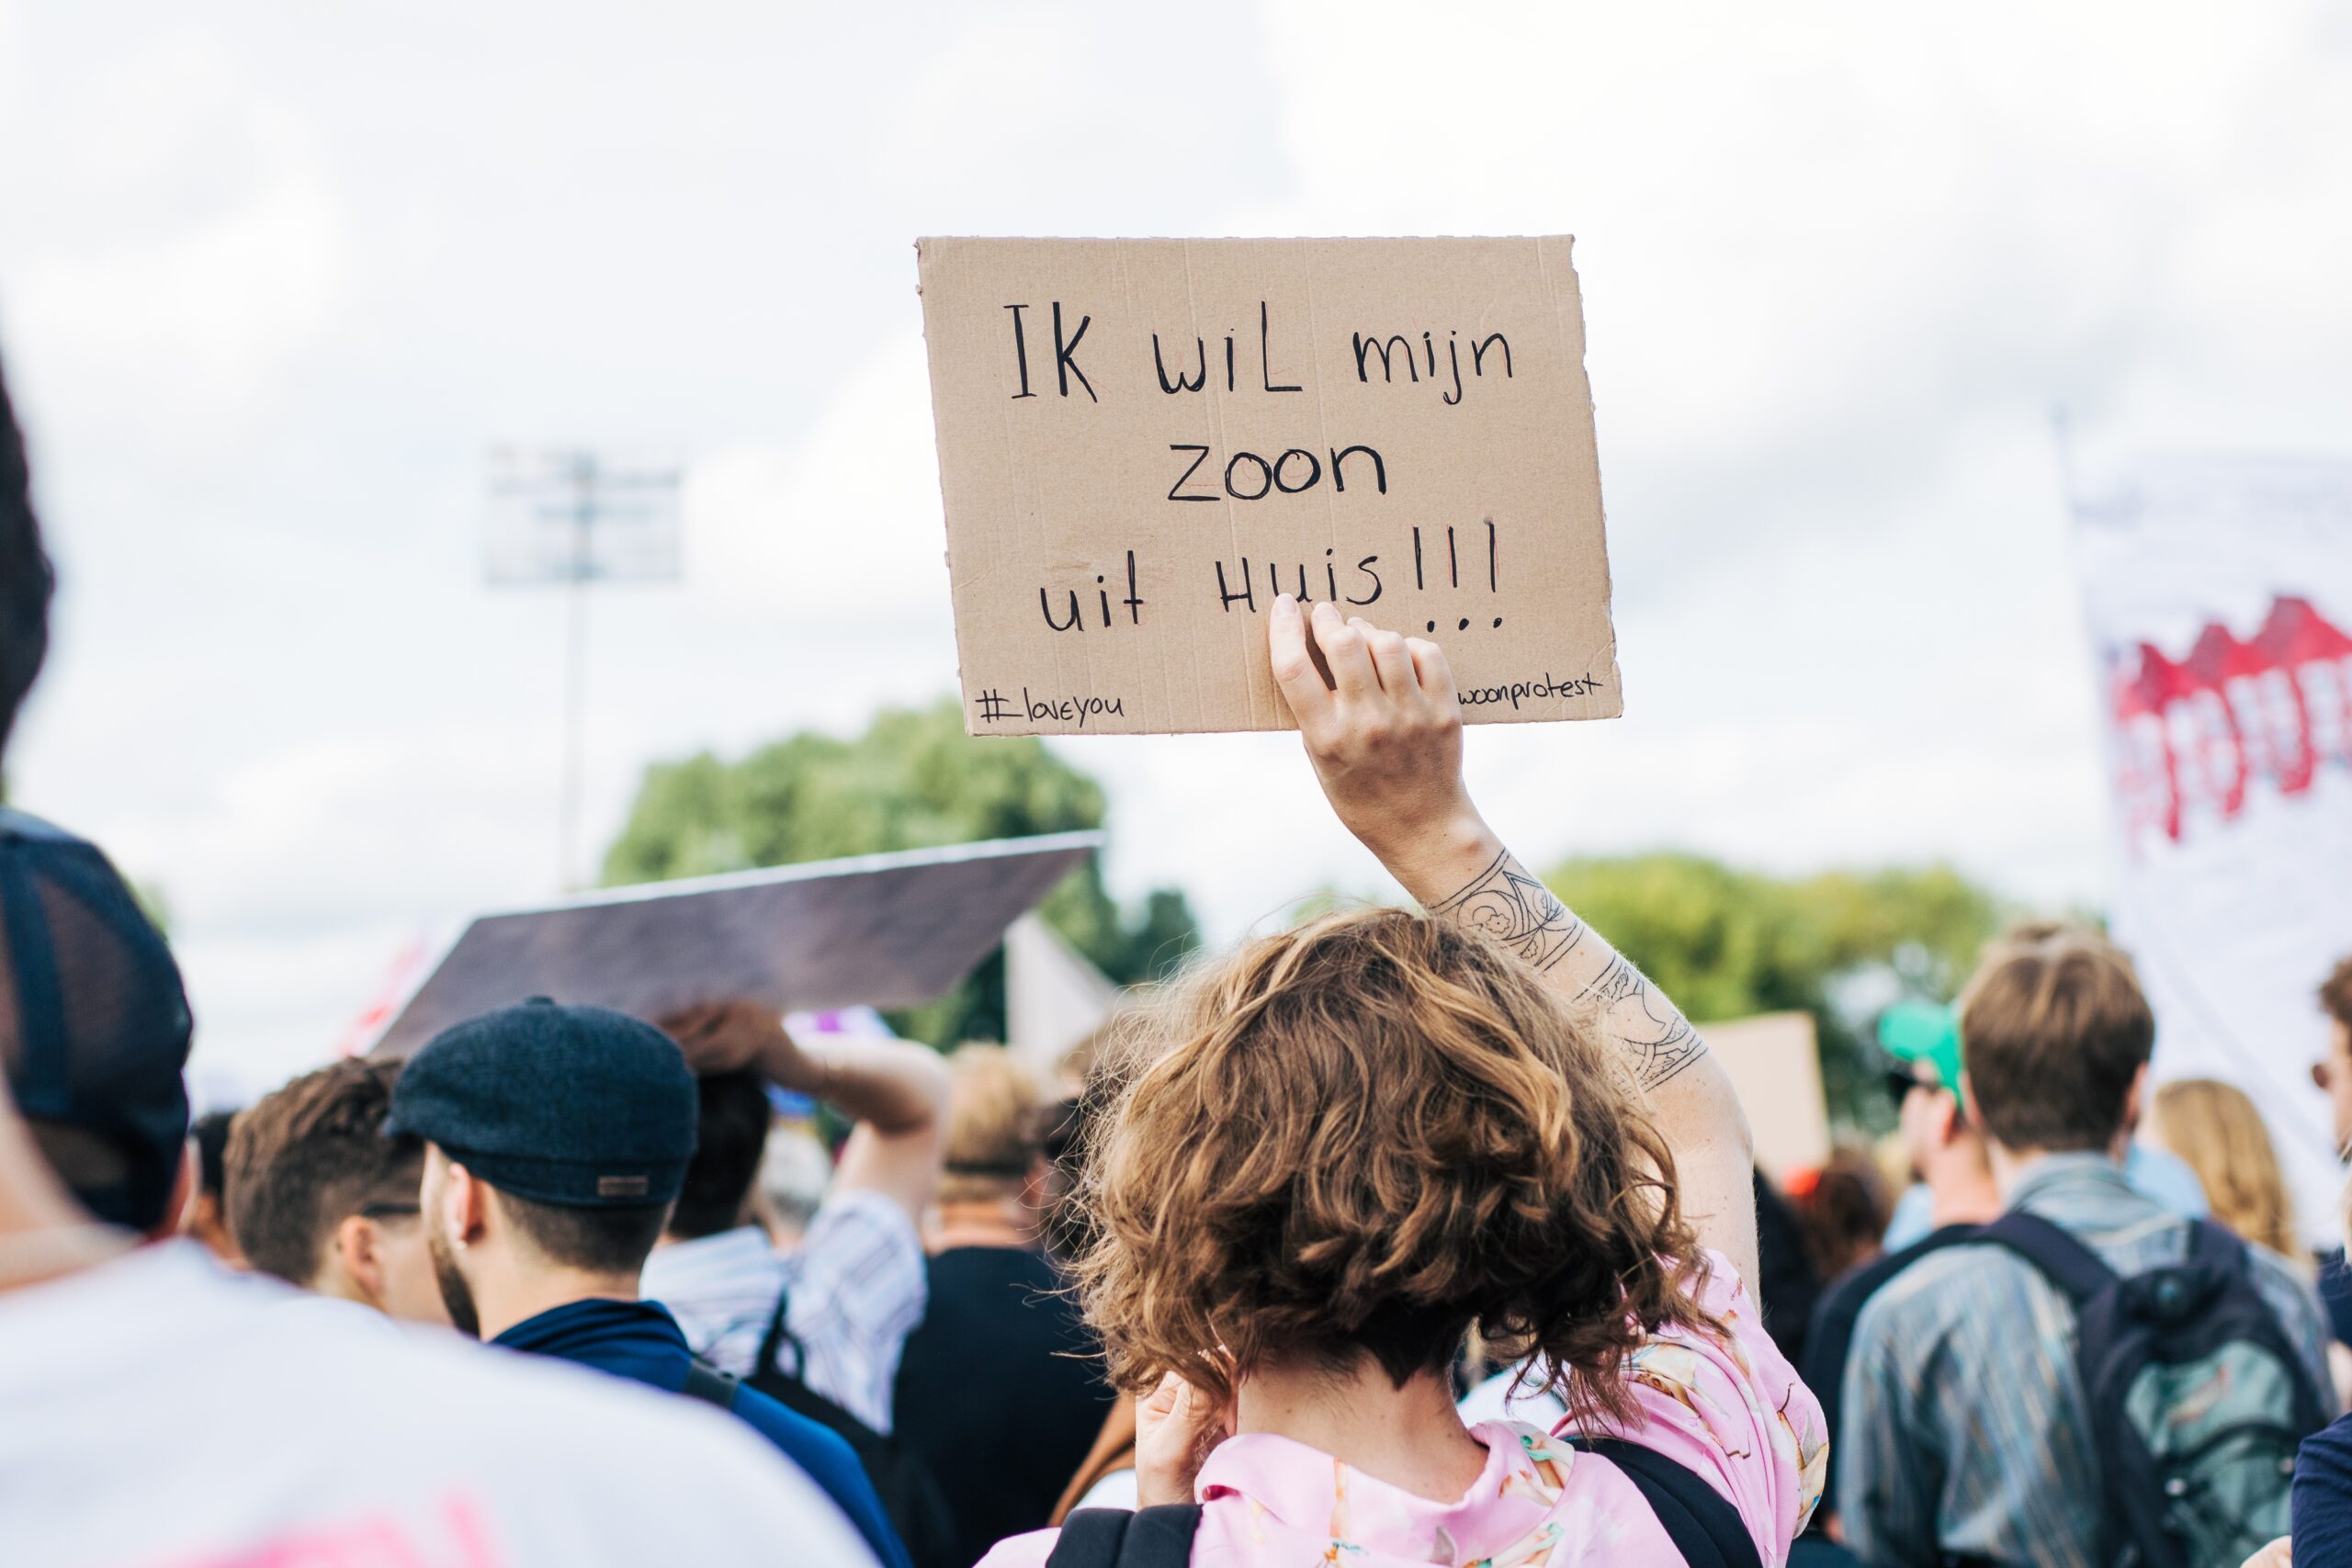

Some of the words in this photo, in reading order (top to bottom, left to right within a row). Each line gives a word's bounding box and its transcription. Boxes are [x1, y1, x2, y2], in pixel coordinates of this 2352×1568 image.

[1351, 330, 1514, 406] mijn
[1166, 444, 1388, 502] zoon
[1039, 548, 1145, 633] uit
[974, 685, 1125, 729] #loveyou
